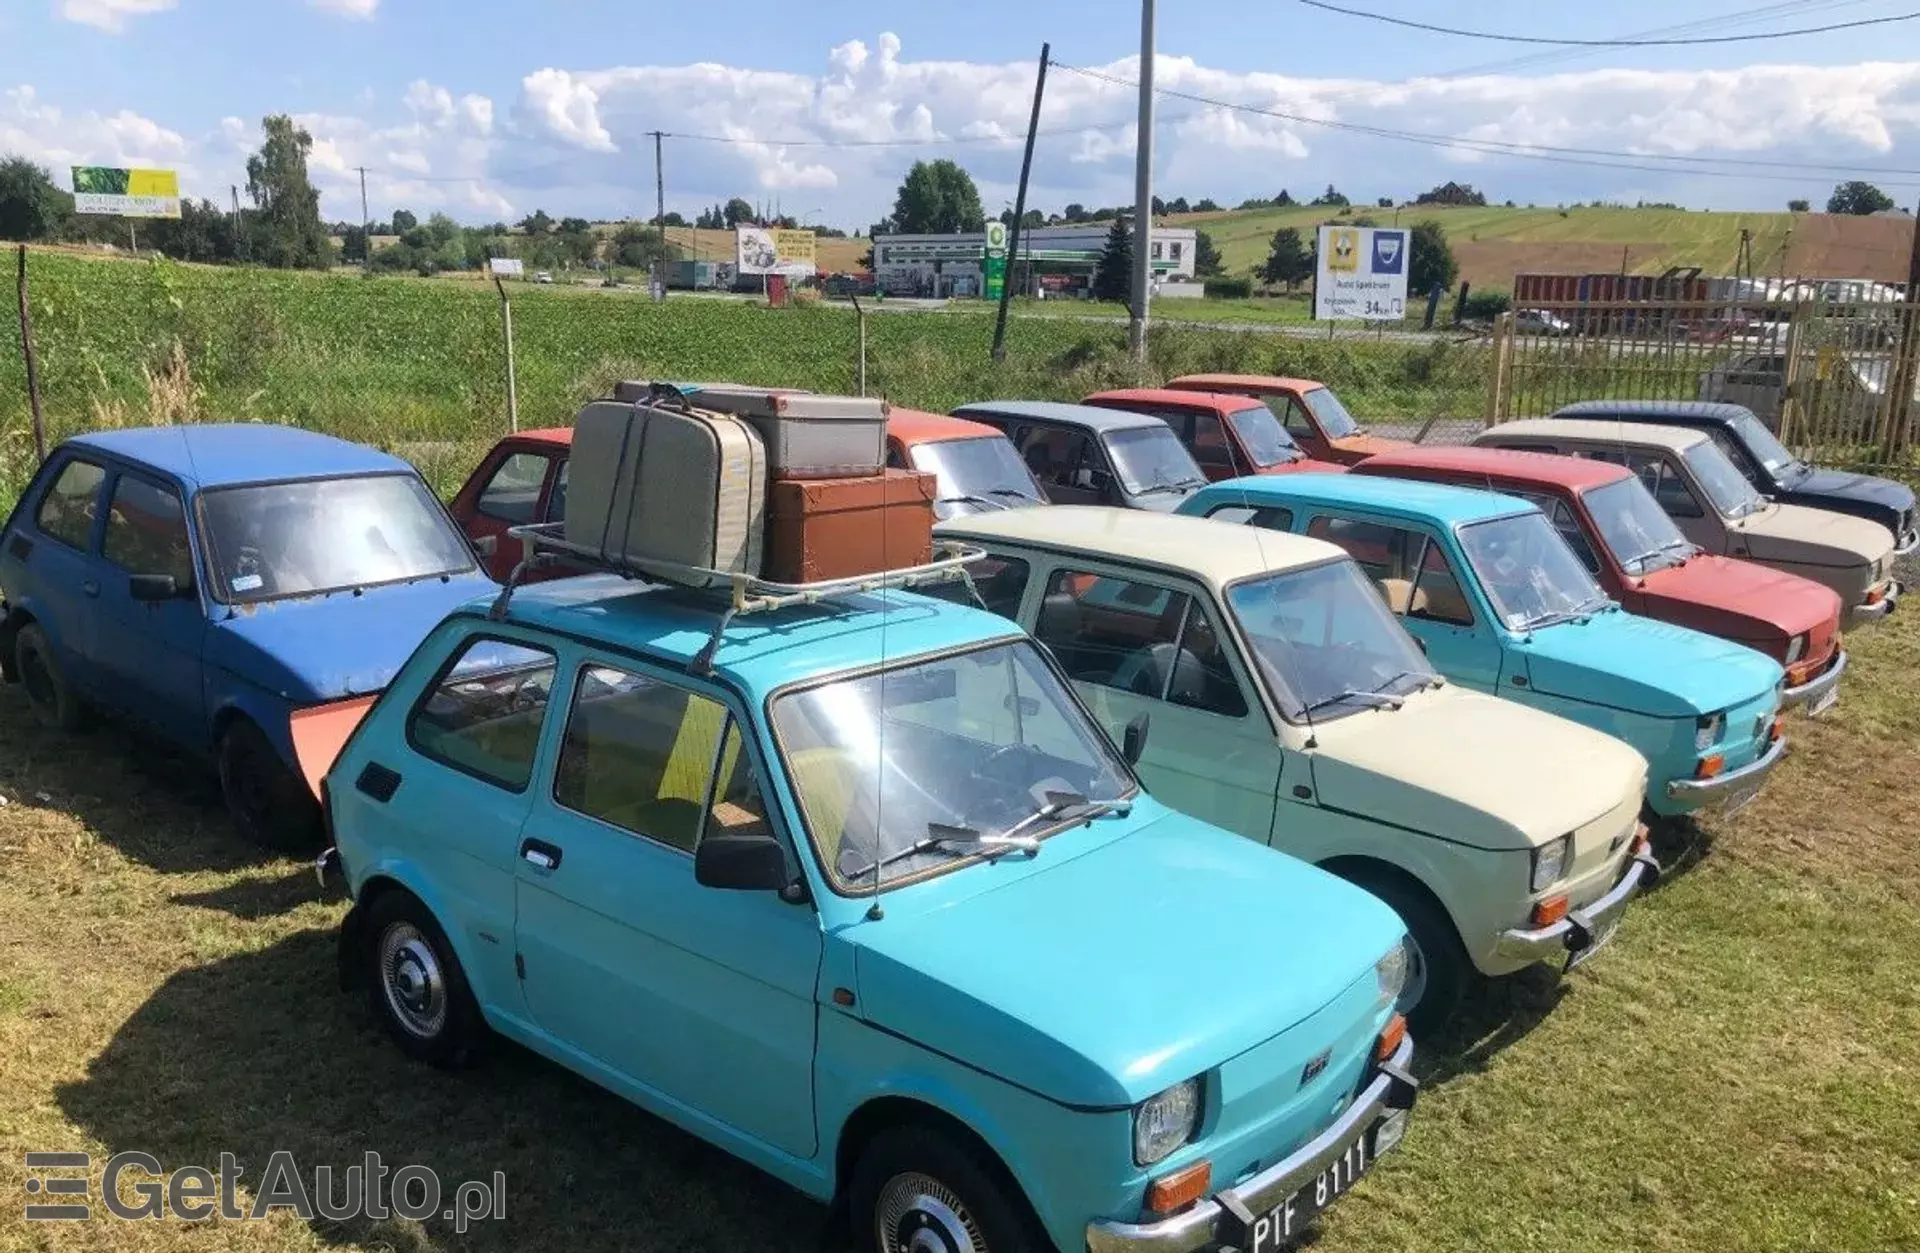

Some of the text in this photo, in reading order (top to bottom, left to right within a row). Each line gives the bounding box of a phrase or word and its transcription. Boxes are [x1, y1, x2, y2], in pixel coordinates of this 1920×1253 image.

[1365, 301, 1379, 315] 34
[1254, 1134, 1364, 1253] PTF 8111
